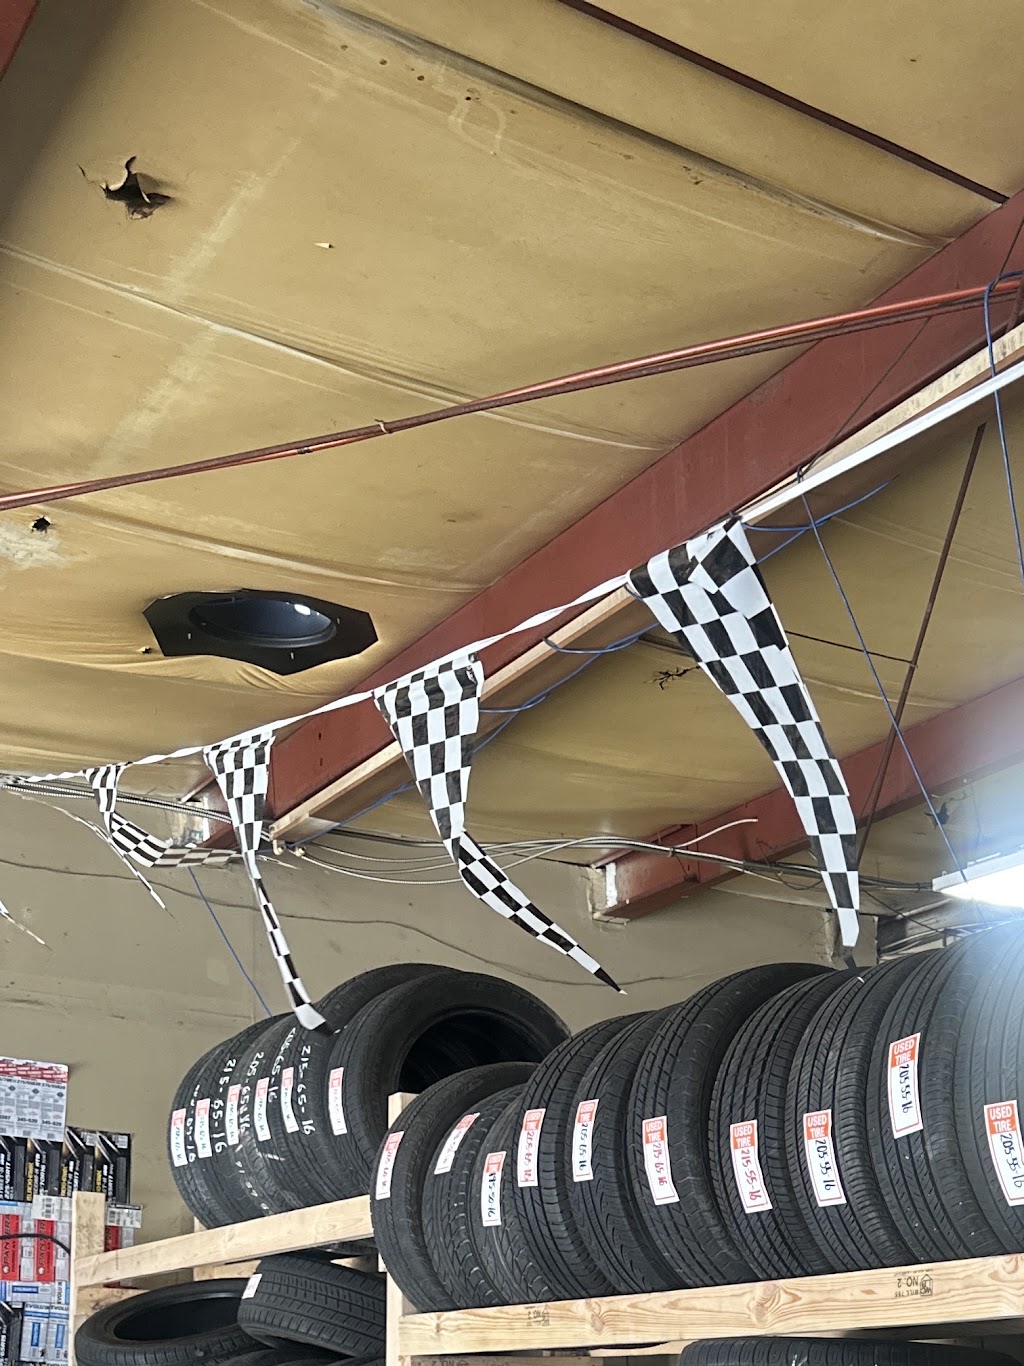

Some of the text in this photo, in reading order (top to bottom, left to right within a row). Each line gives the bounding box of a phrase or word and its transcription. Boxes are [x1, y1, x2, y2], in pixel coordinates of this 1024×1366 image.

[893, 1037, 914, 1055] USED
[895, 1051, 912, 1065] TIRE
[989, 1105, 1012, 1120] USED
[807, 1114, 827, 1126] USED
[993, 1120, 1012, 1132] TIRE
[645, 1120, 663, 1133] USED
[733, 1126, 752, 1138] USED
[810, 1126, 825, 1138] TIRE
[736, 1137, 751, 1148] TIRE
[741, 1148, 761, 1201] 215-55-16
